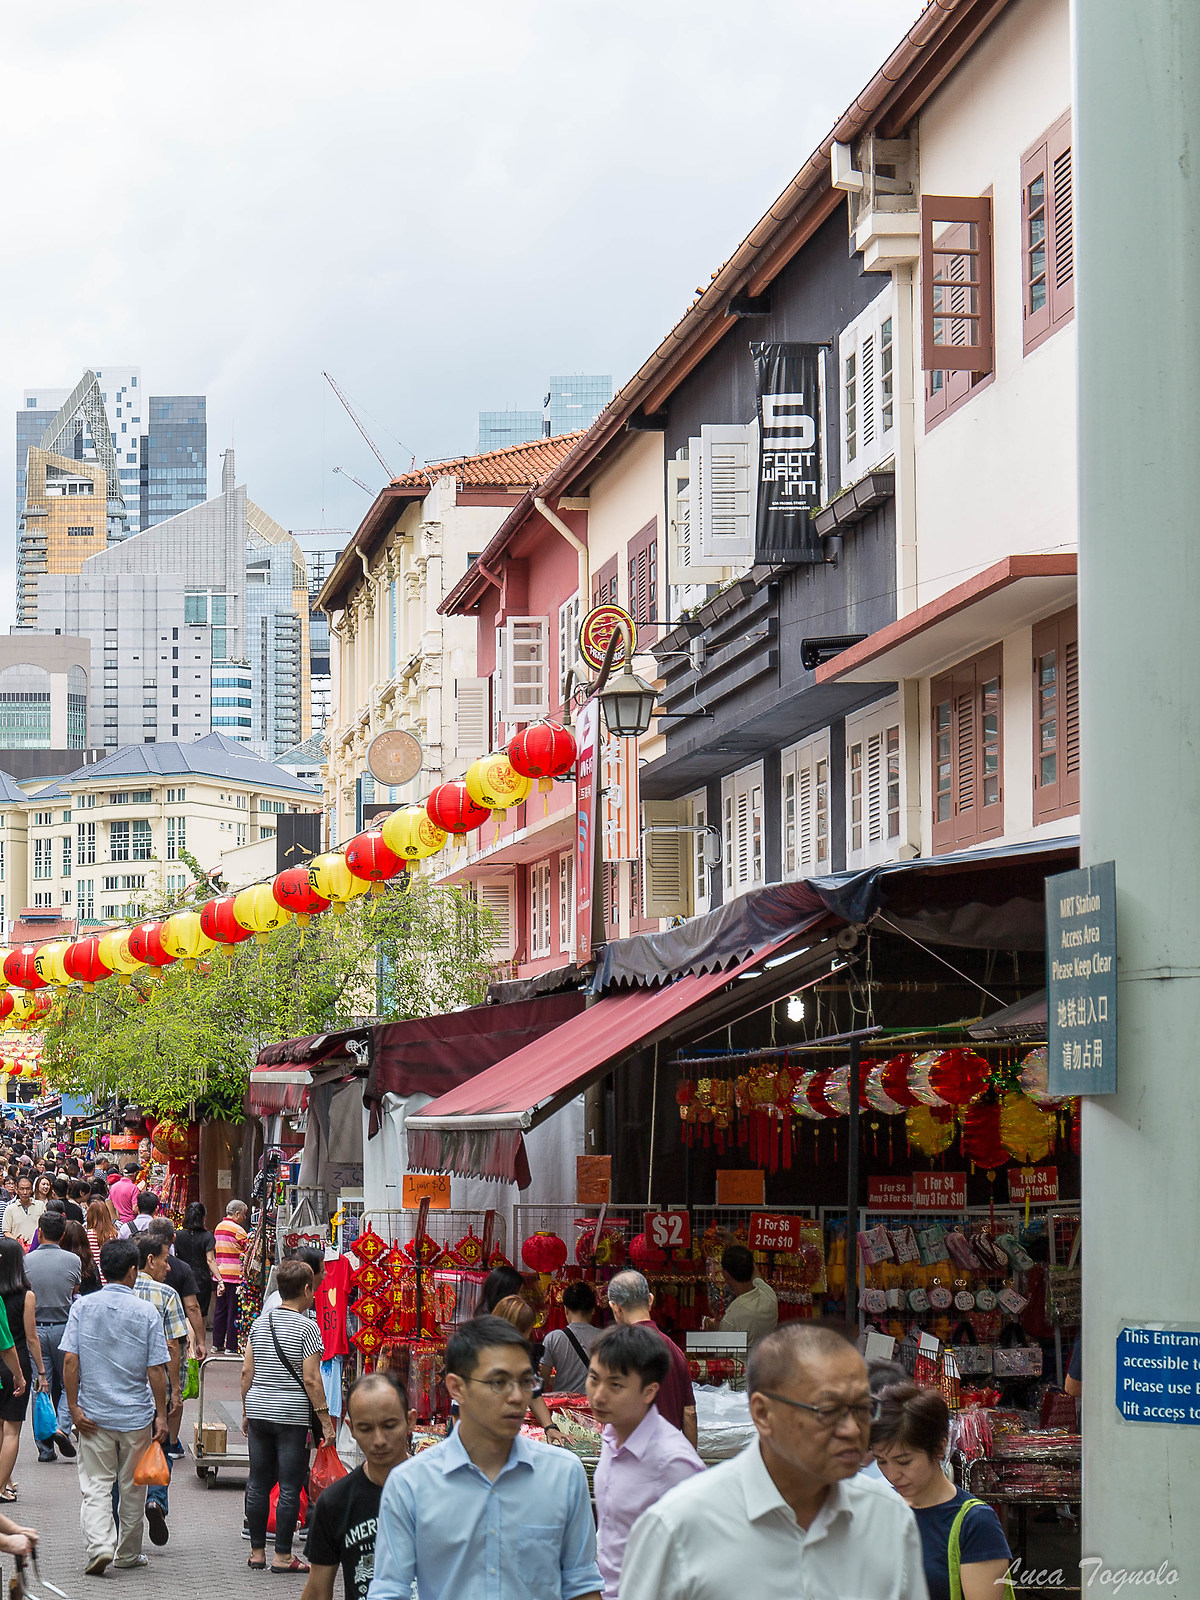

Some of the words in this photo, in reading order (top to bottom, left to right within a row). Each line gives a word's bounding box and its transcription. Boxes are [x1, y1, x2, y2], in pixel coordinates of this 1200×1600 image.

[762, 393, 816, 450] 5
[762, 452, 816, 467] FOOT
[762, 466, 802, 482] WAY
[1060, 897, 1074, 918] MRT
[1076, 893, 1101, 916] Station
[1061, 927, 1083, 949] Access
[1083, 925, 1100, 944] Area
[1052, 959, 1074, 981] Please
[1074, 957, 1092, 980] Keep
[1092, 953, 1112, 975] Clear
[1057, 995, 1109, 1028] 地铁出入口
[1062, 1039, 1103, 1071] 请勿占用
[924, 1178, 928, 1189] 1
[930, 1178, 942, 1190] For
[944, 1177, 954, 1189] $4
[1037, 1172, 1047, 1183] $4
[408, 1178, 416, 1192] 1
[416, 1182, 430, 1193] pair
[431, 1178, 447, 1192] $8
[883, 1184, 896, 1192] For
[896, 1184, 906, 1192] $4
[1043, 1184, 1057, 1196] $10
[889, 1194, 901, 1203] For
[916, 1193, 930, 1206] Any
[930, 1193, 936, 1205] 3
[937, 1193, 948, 1205] For
[950, 1192, 964, 1206] $10
[652, 1214, 683, 1247] $2
[757, 1218, 762, 1229] 1
[764, 1218, 777, 1231] For
[779, 1219, 790, 1232] $6
[755, 1234, 761, 1245] 2
[763, 1235, 776, 1247] For
[777, 1236, 793, 1248] $10
[323, 1310, 338, 1331] SG
[1123, 1330, 1150, 1344] This
[1123, 1355, 1189, 1370] accessible
[1123, 1377, 1164, 1393] Please
[1167, 1382, 1192, 1395] use
[1123, 1401, 1140, 1416] lift
[1143, 1406, 1186, 1419] access
[344, 1517, 379, 1549] AMER
